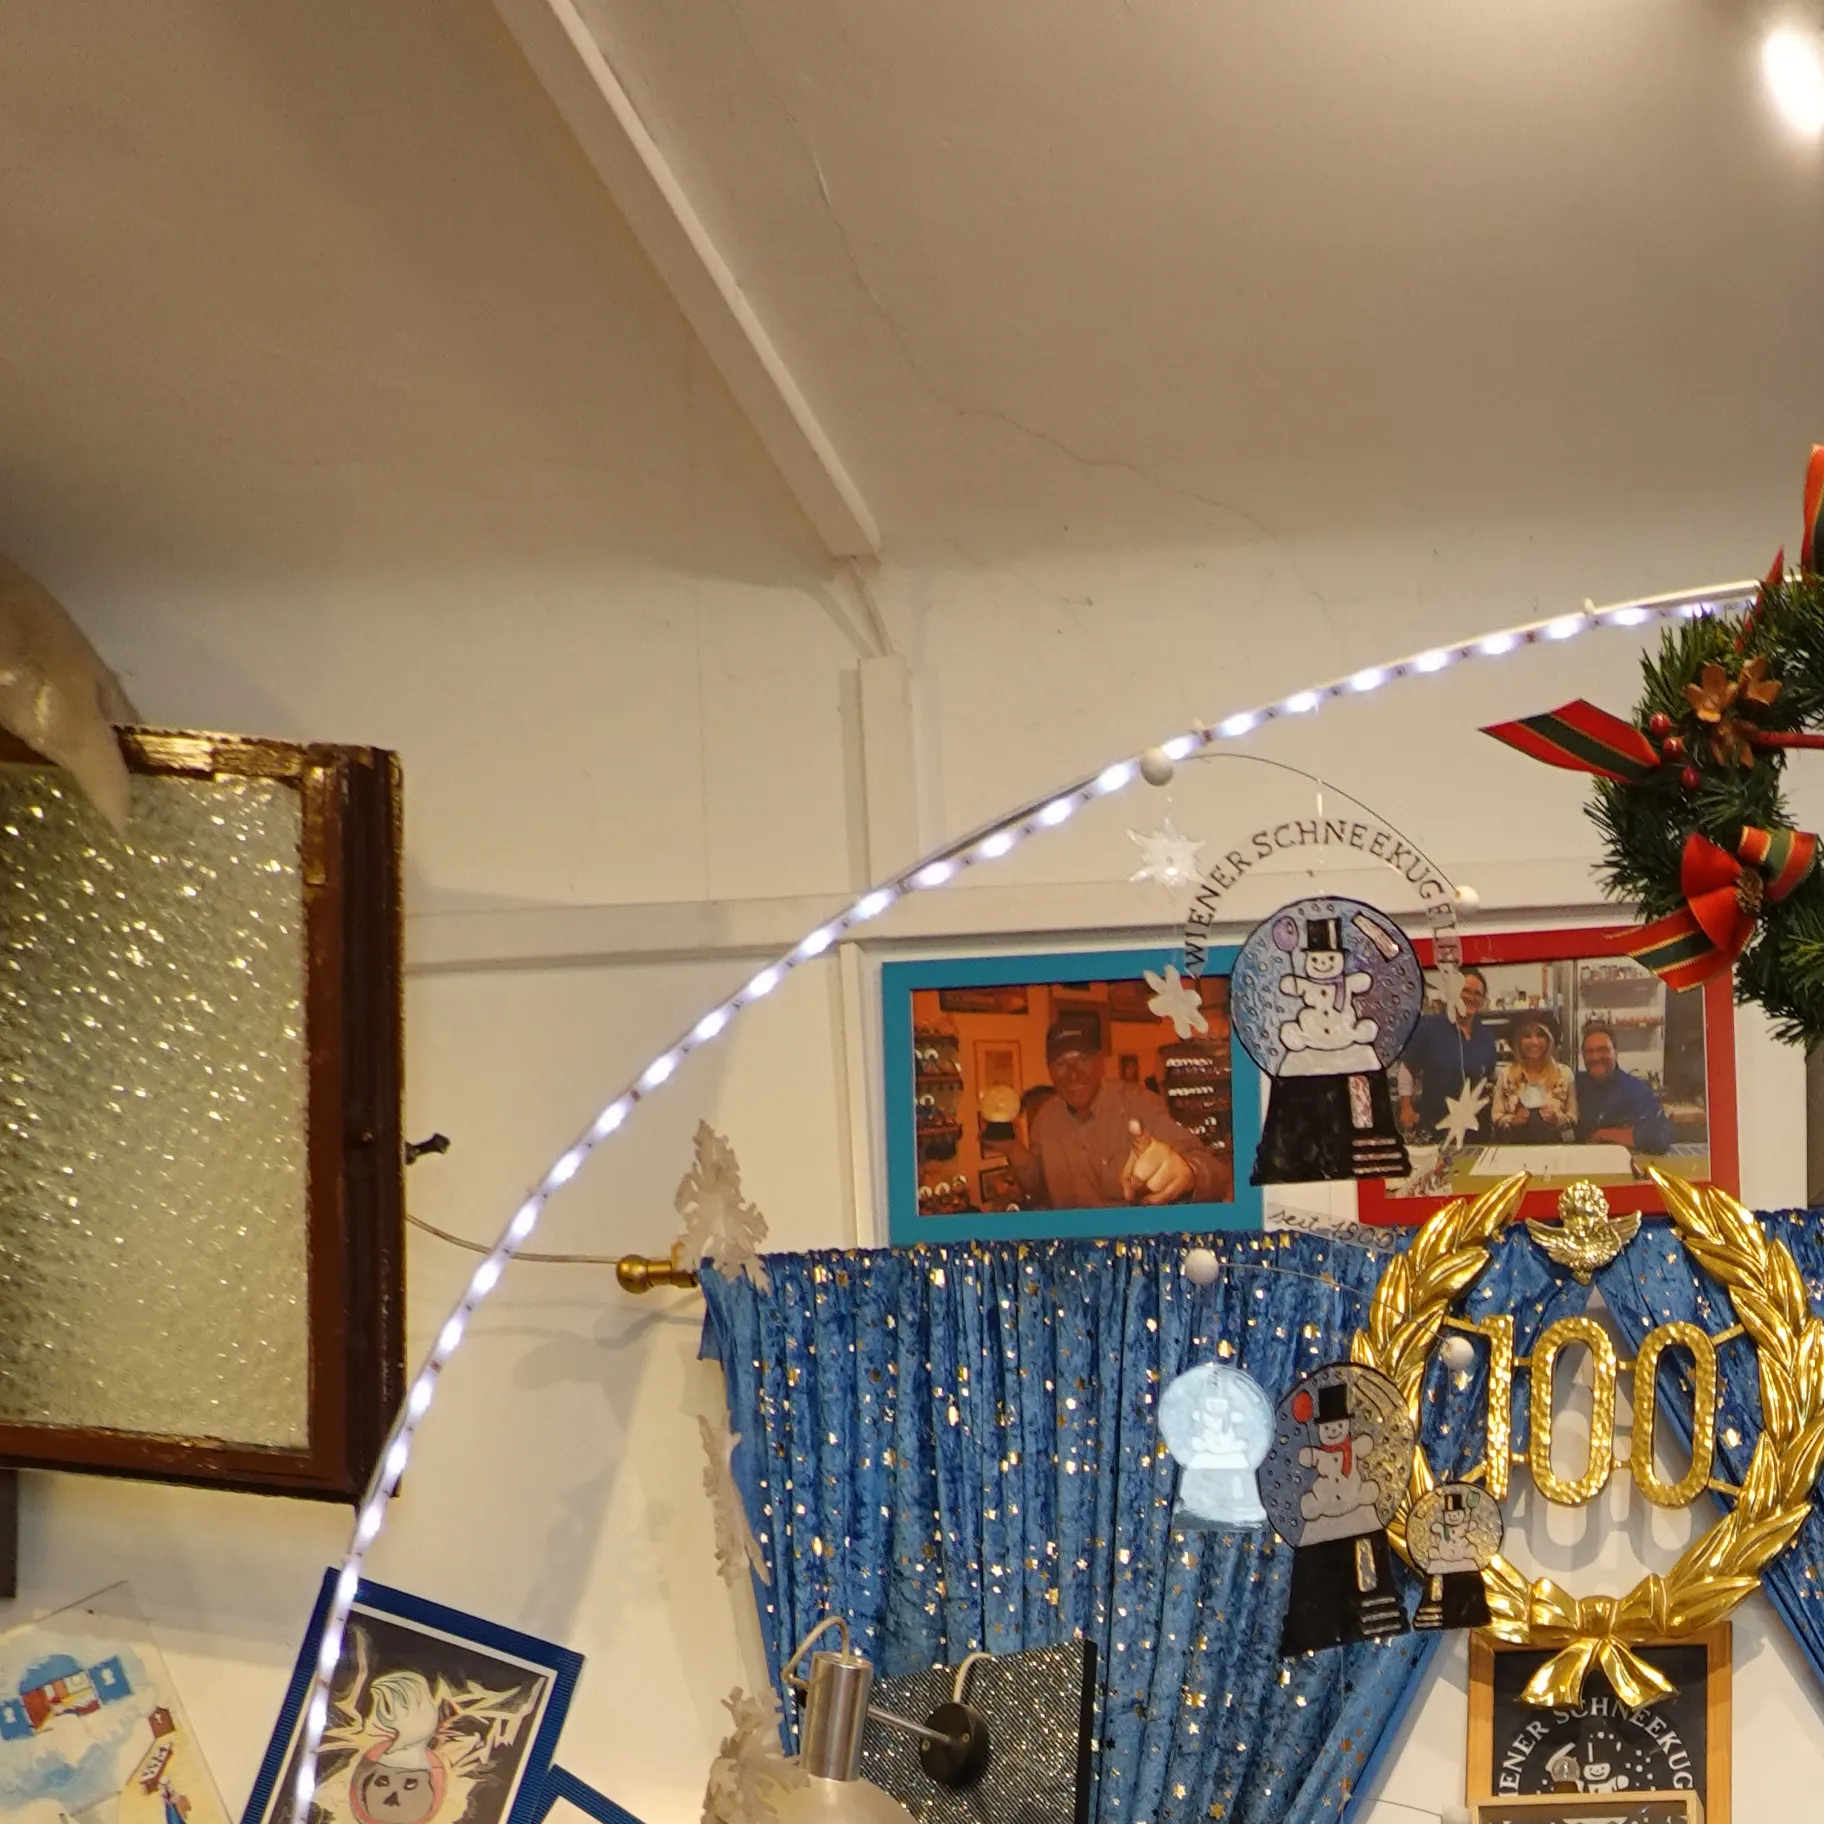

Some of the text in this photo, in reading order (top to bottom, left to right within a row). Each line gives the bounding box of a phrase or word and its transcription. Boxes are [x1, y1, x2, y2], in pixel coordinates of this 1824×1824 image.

[1187, 852, 1253, 967] WIENER
[1268, 1209, 1319, 1233] seit
[1476, 1313, 1718, 1509] 100
[1498, 1696, 1694, 1797] IENER SCHNEEKUG
